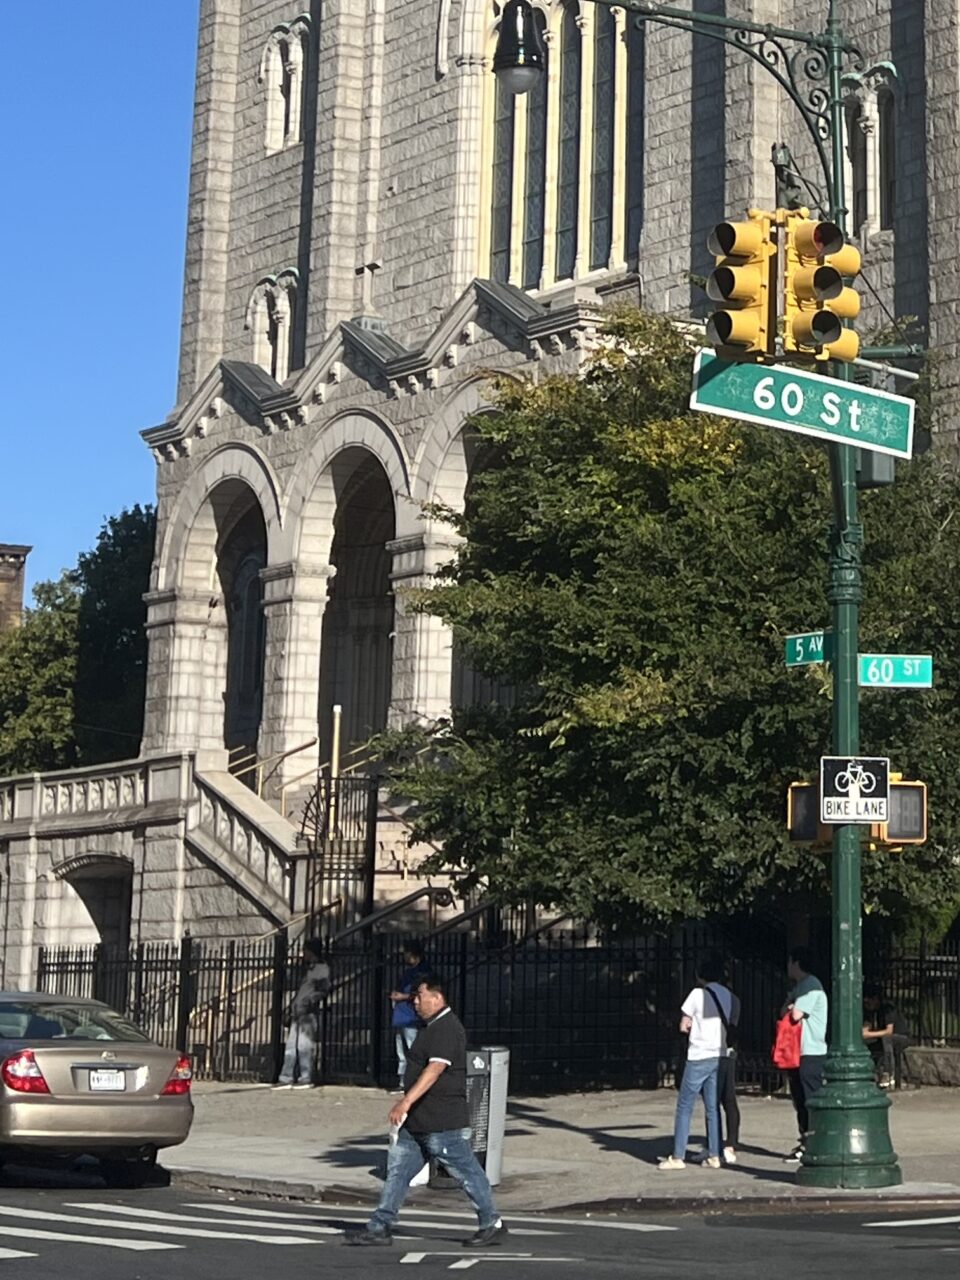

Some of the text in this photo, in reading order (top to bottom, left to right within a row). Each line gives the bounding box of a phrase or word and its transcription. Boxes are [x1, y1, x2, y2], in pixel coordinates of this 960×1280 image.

[753, 376, 862, 432] 60 St
[795, 635, 824, 661] 5 AV
[867, 660, 922, 683] 60 ST
[826, 800, 885, 816] BIKE LANE
